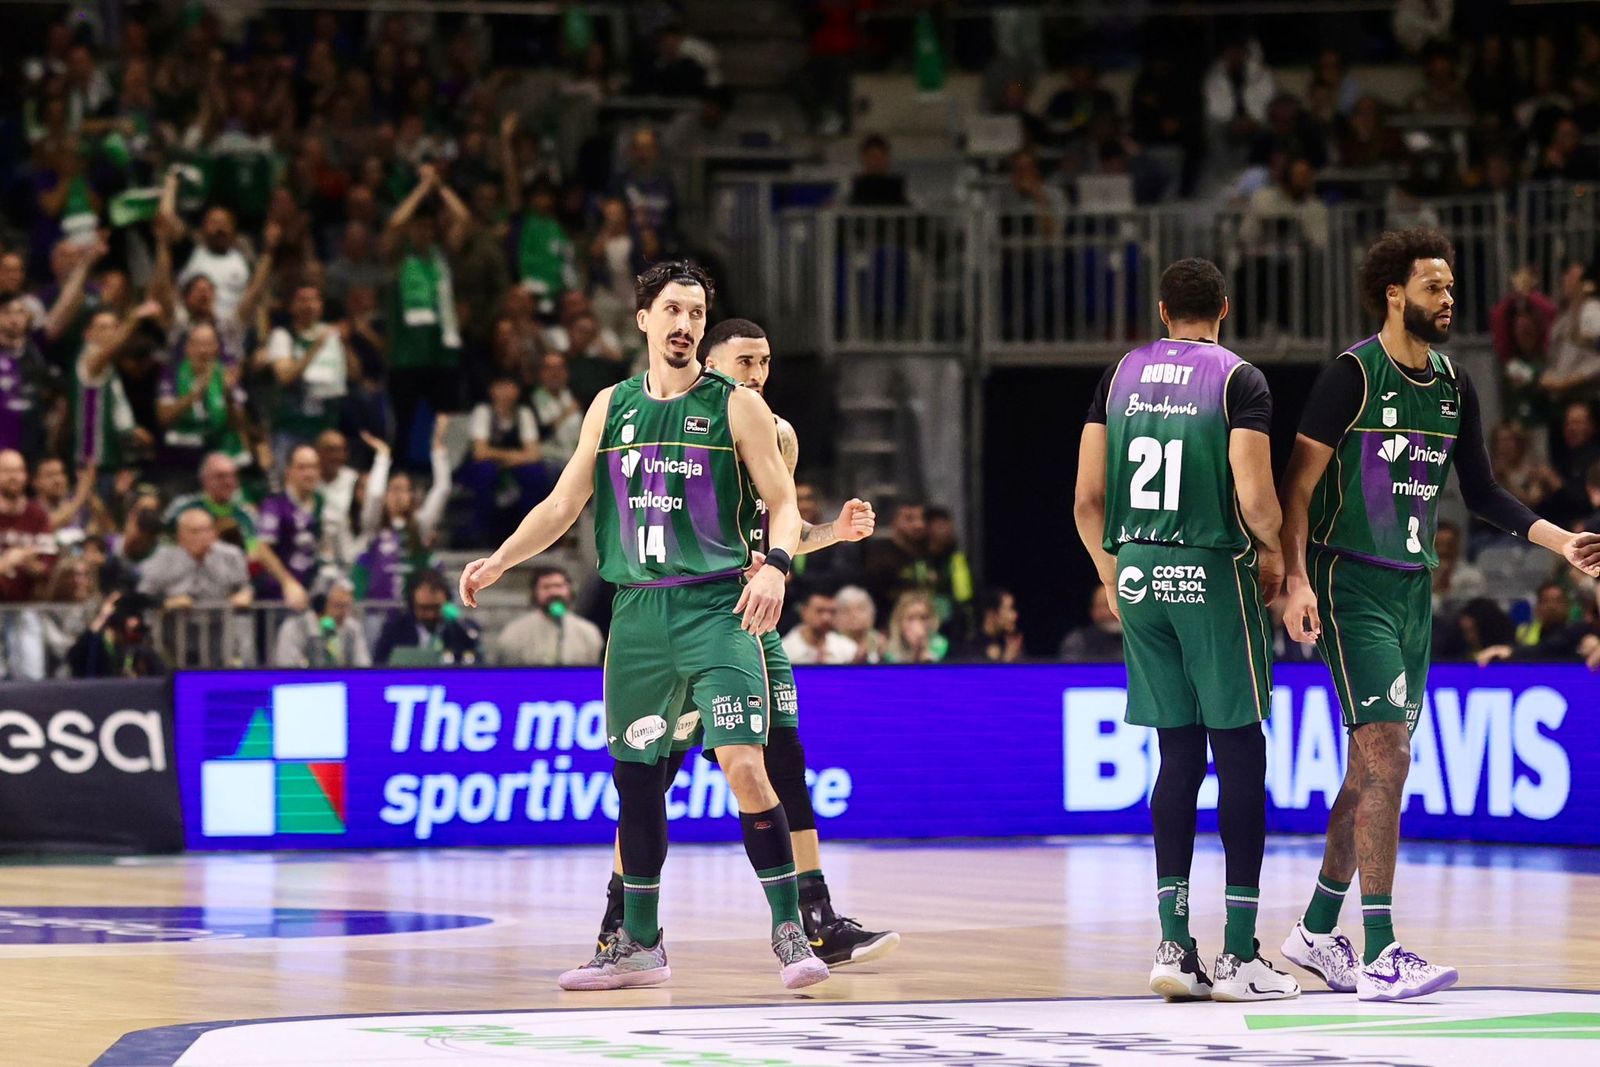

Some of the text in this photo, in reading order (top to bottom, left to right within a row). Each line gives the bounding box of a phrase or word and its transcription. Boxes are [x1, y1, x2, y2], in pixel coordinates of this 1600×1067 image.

[1140, 364, 1194, 385] RUBIT
[644, 458, 703, 479] Unicaja
[1128, 436, 1183, 511] 21
[637, 525, 666, 563] 14
[1406, 516, 1421, 554] 3
[1152, 565, 1206, 579] COSTA
[1152, 580, 1206, 592] DEL SOL
[384, 684, 607, 752] The mo
[713, 712, 745, 730] laga
